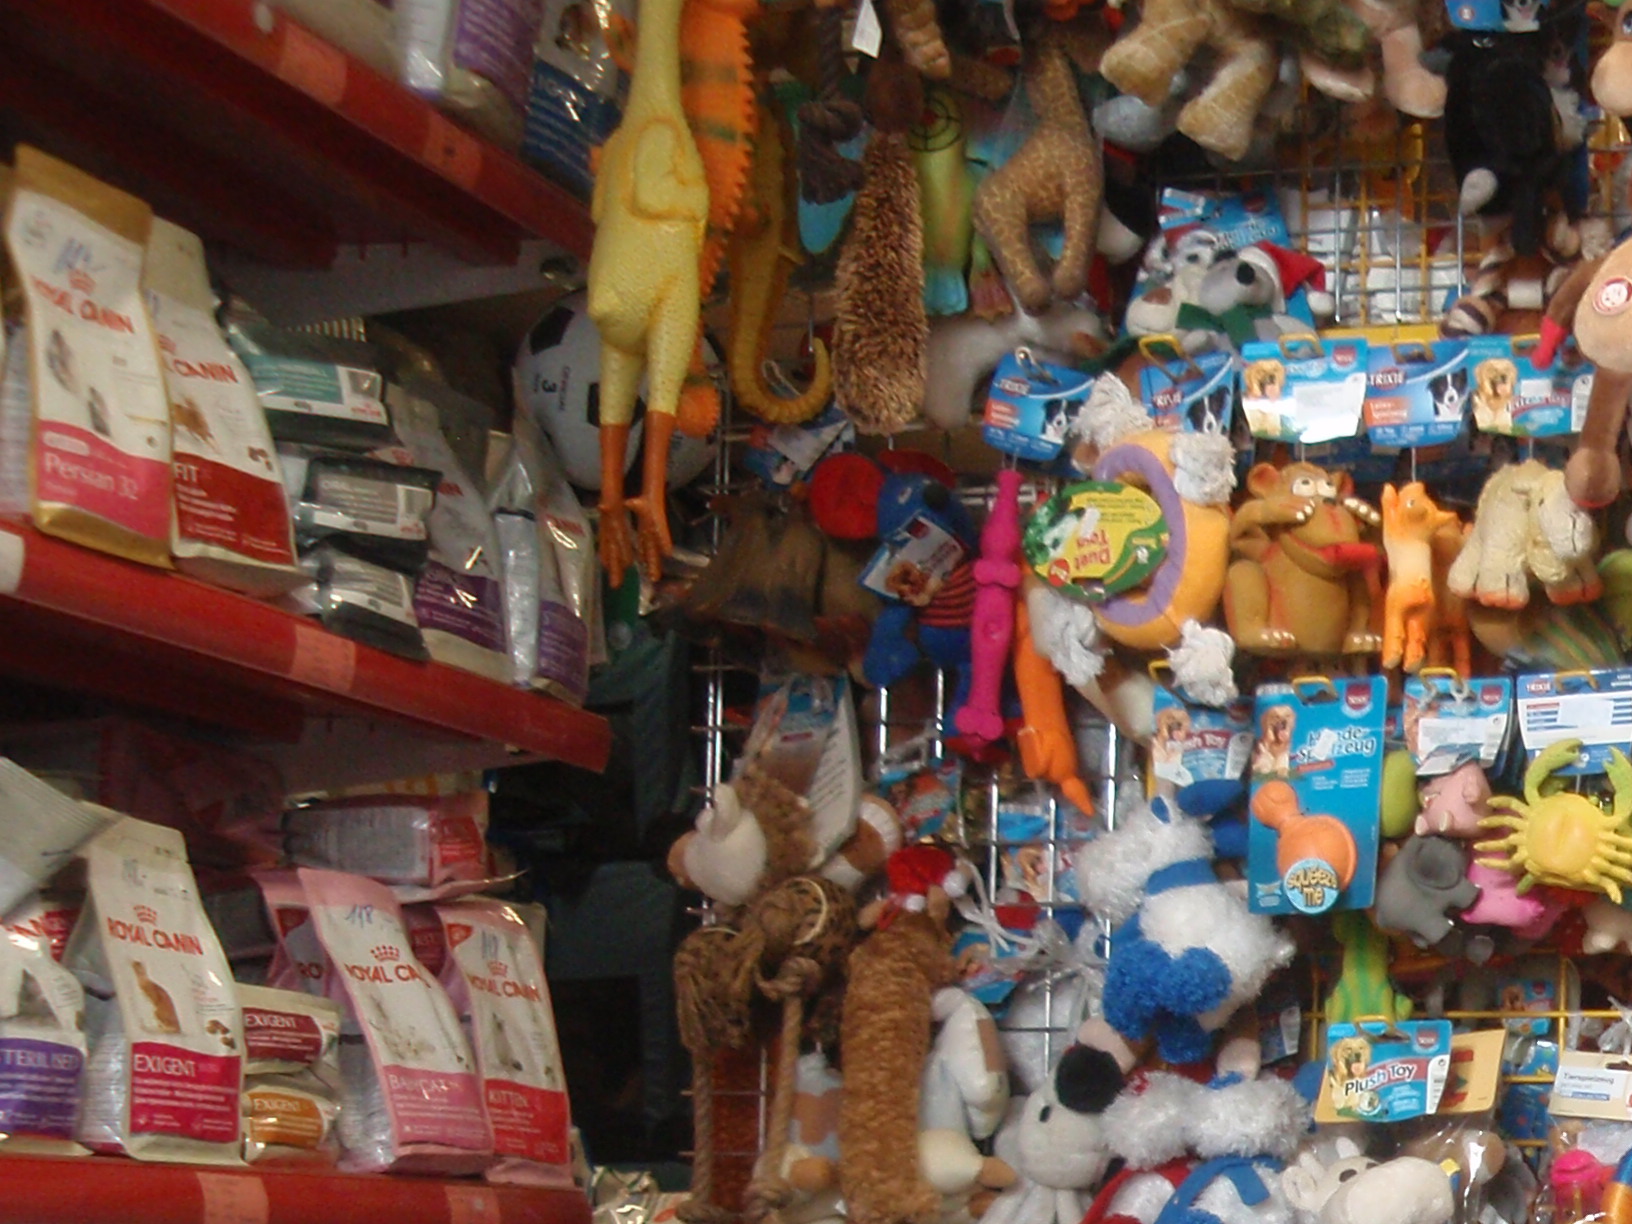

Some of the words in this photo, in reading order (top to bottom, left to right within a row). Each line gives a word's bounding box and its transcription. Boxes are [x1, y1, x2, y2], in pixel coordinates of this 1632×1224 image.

[45, 454, 115, 490] Persian
[117, 478, 140, 502] 32
[175, 463, 201, 485] FIT
[1309, 725, 1370, 744] Hde-
[1298, 738, 1375, 762] Spzeug
[1303, 889, 1326, 906] me
[106, 916, 153, 947] ROYAL
[152, 929, 204, 955] CANIN
[244, 1013, 298, 1029] EXIGENT
[0, 1050, 80, 1071] TERILISED
[132, 1054, 197, 1078] EXIGENT
[1344, 1068, 1387, 1096] Plush
[1389, 1062, 1417, 1080] Toy
